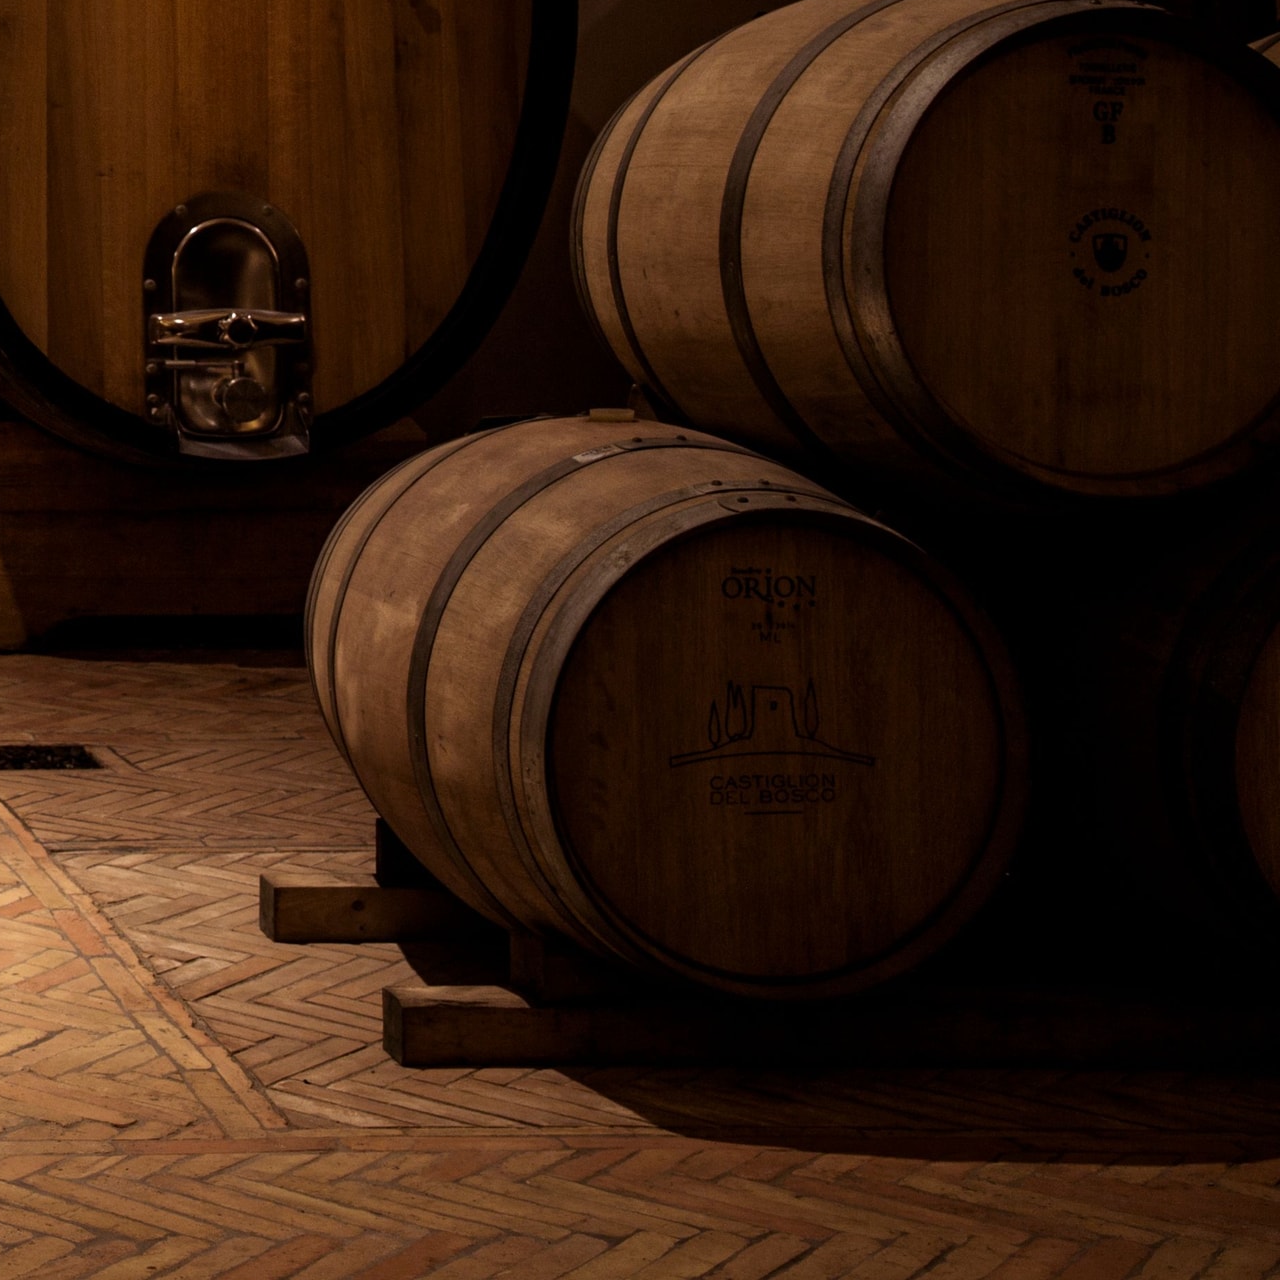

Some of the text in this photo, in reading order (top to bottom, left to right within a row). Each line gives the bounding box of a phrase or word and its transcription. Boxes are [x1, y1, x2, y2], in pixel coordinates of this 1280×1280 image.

[1101, 123, 1116, 144] B
[1069, 207, 1152, 243] CASTIGLION
[709, 773, 836, 790] CASTIGLION
[709, 788, 836, 805] DEL BOSCO
